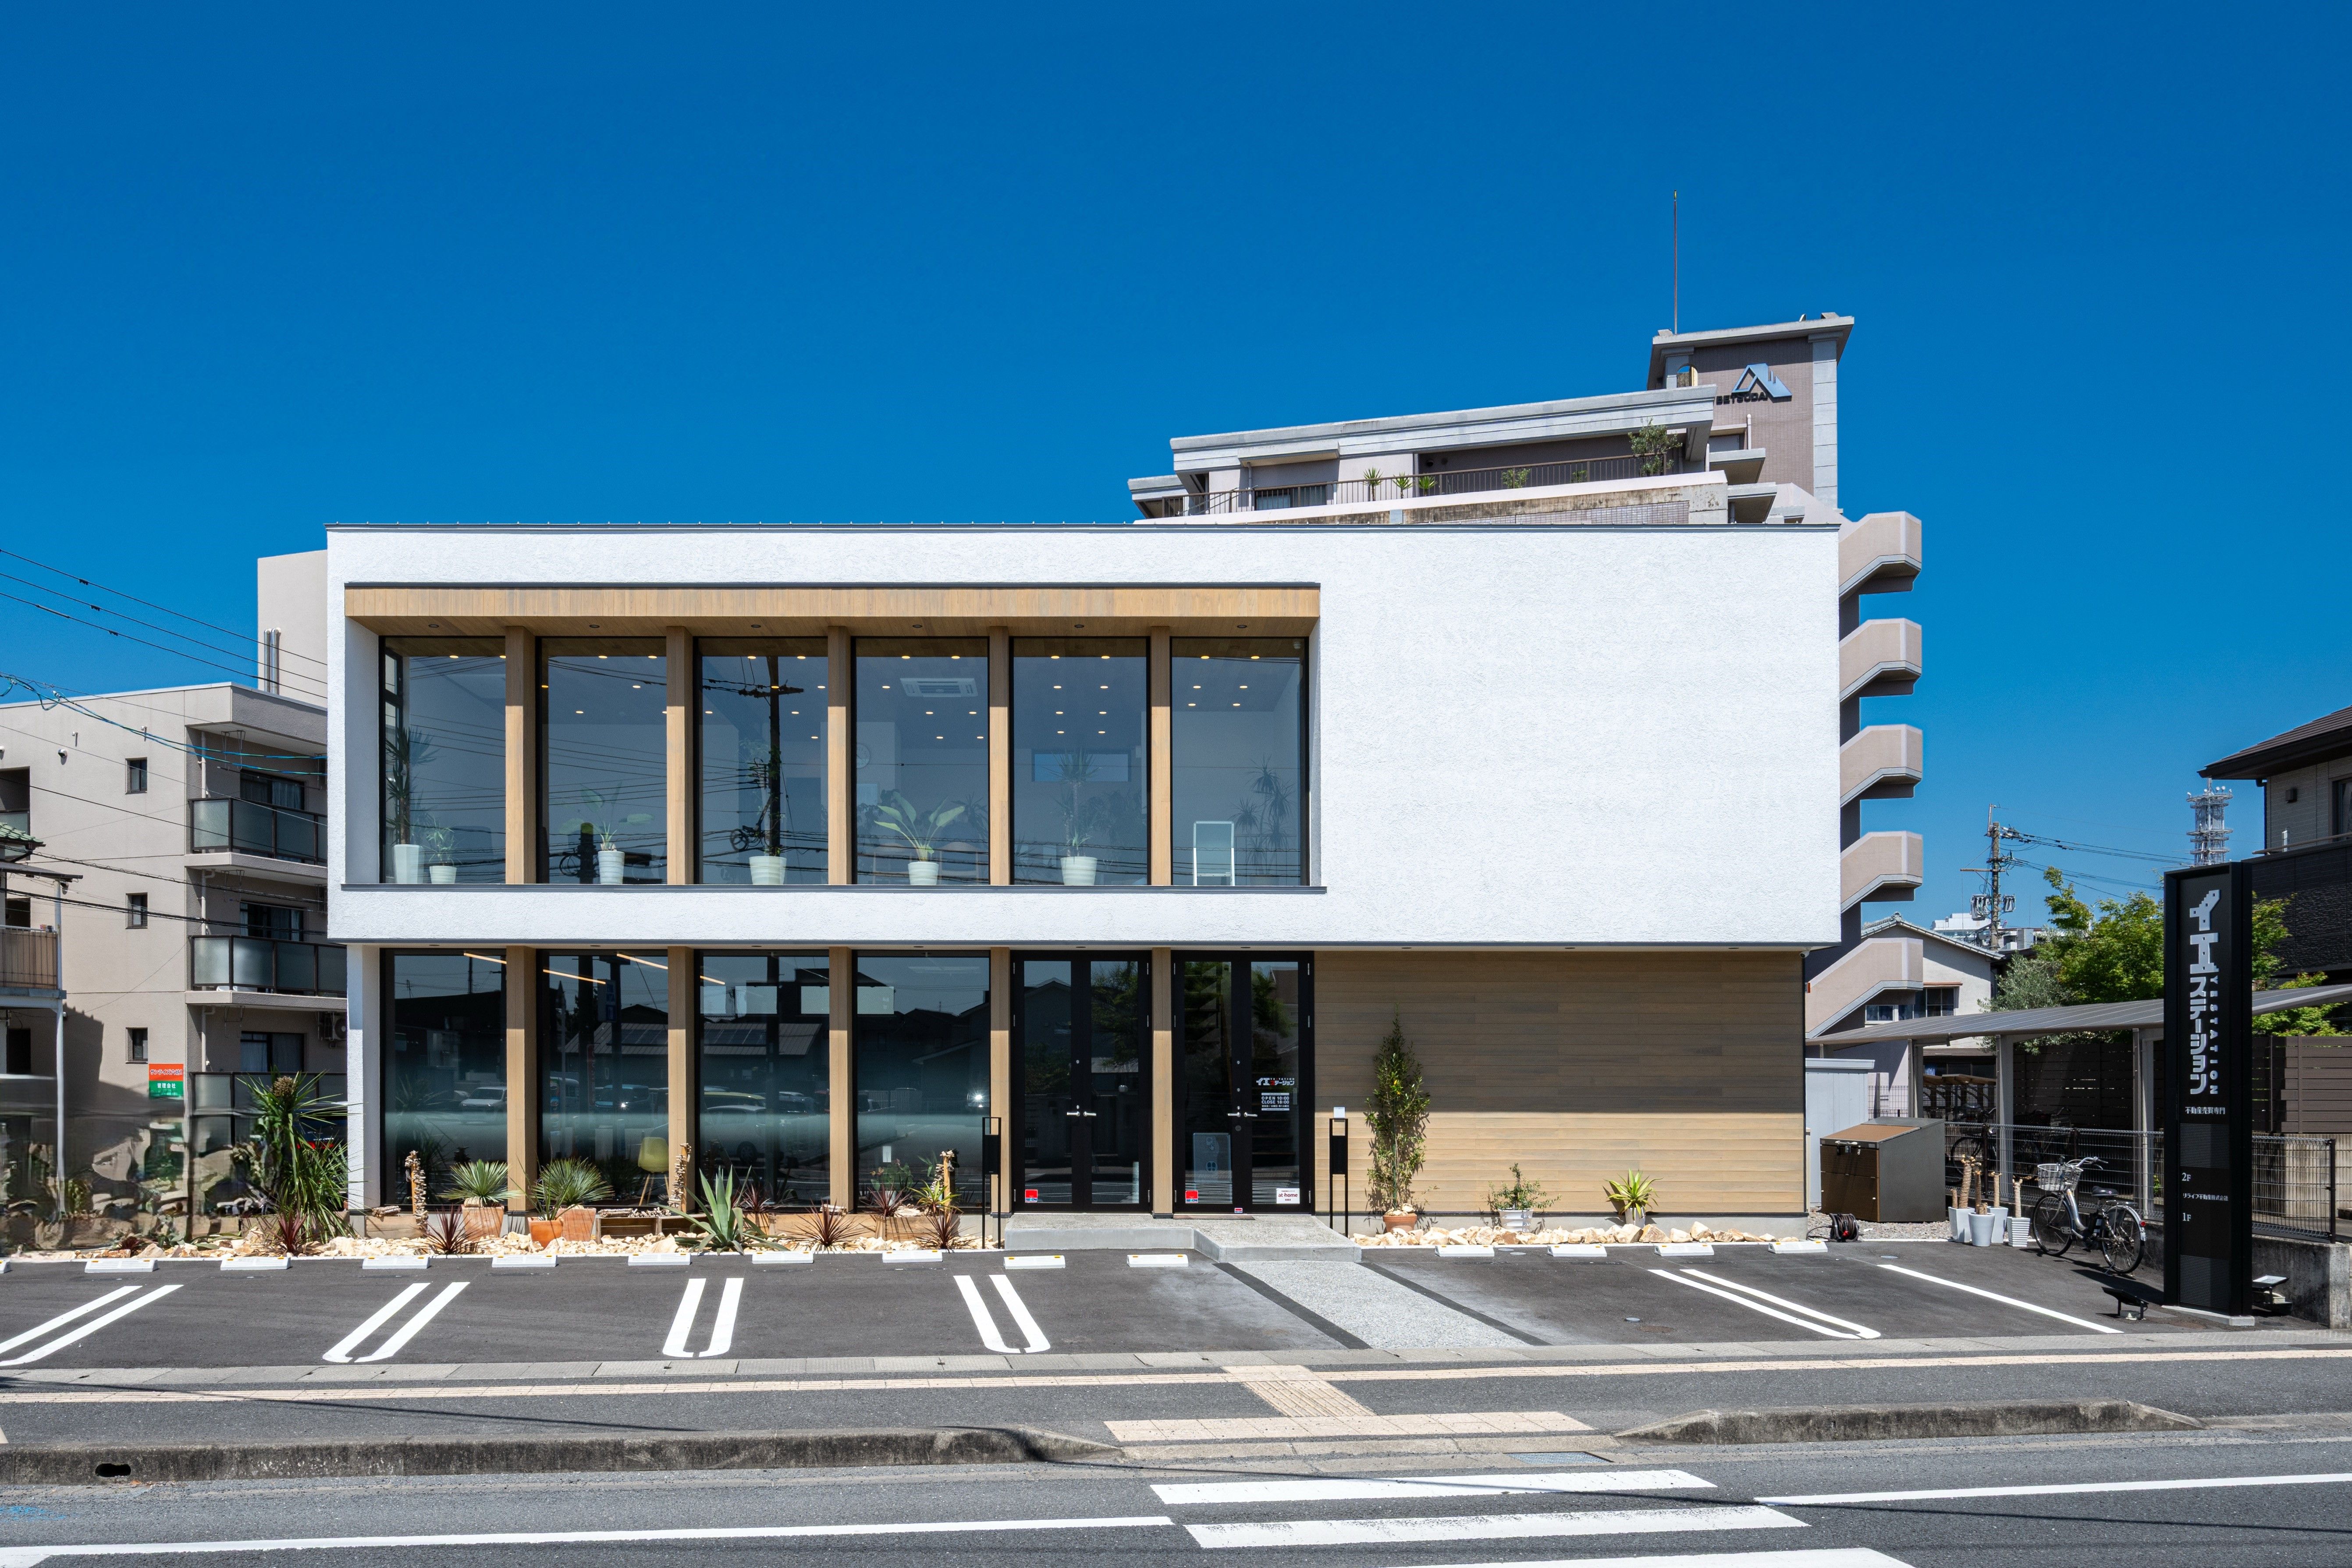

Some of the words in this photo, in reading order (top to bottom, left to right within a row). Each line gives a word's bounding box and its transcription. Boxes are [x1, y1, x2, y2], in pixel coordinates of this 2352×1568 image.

[2189, 889, 2221, 1095] イエステーション
[2210, 975, 2219, 1094] YESTATION
[2185, 1106, 2226, 1115] 不動産売買専門
[2182, 1173, 2191, 1181] 2F
[2183, 1193, 2228, 1201] リライフ不動産株式会社
[2182, 1212, 2191, 1222] 1F
